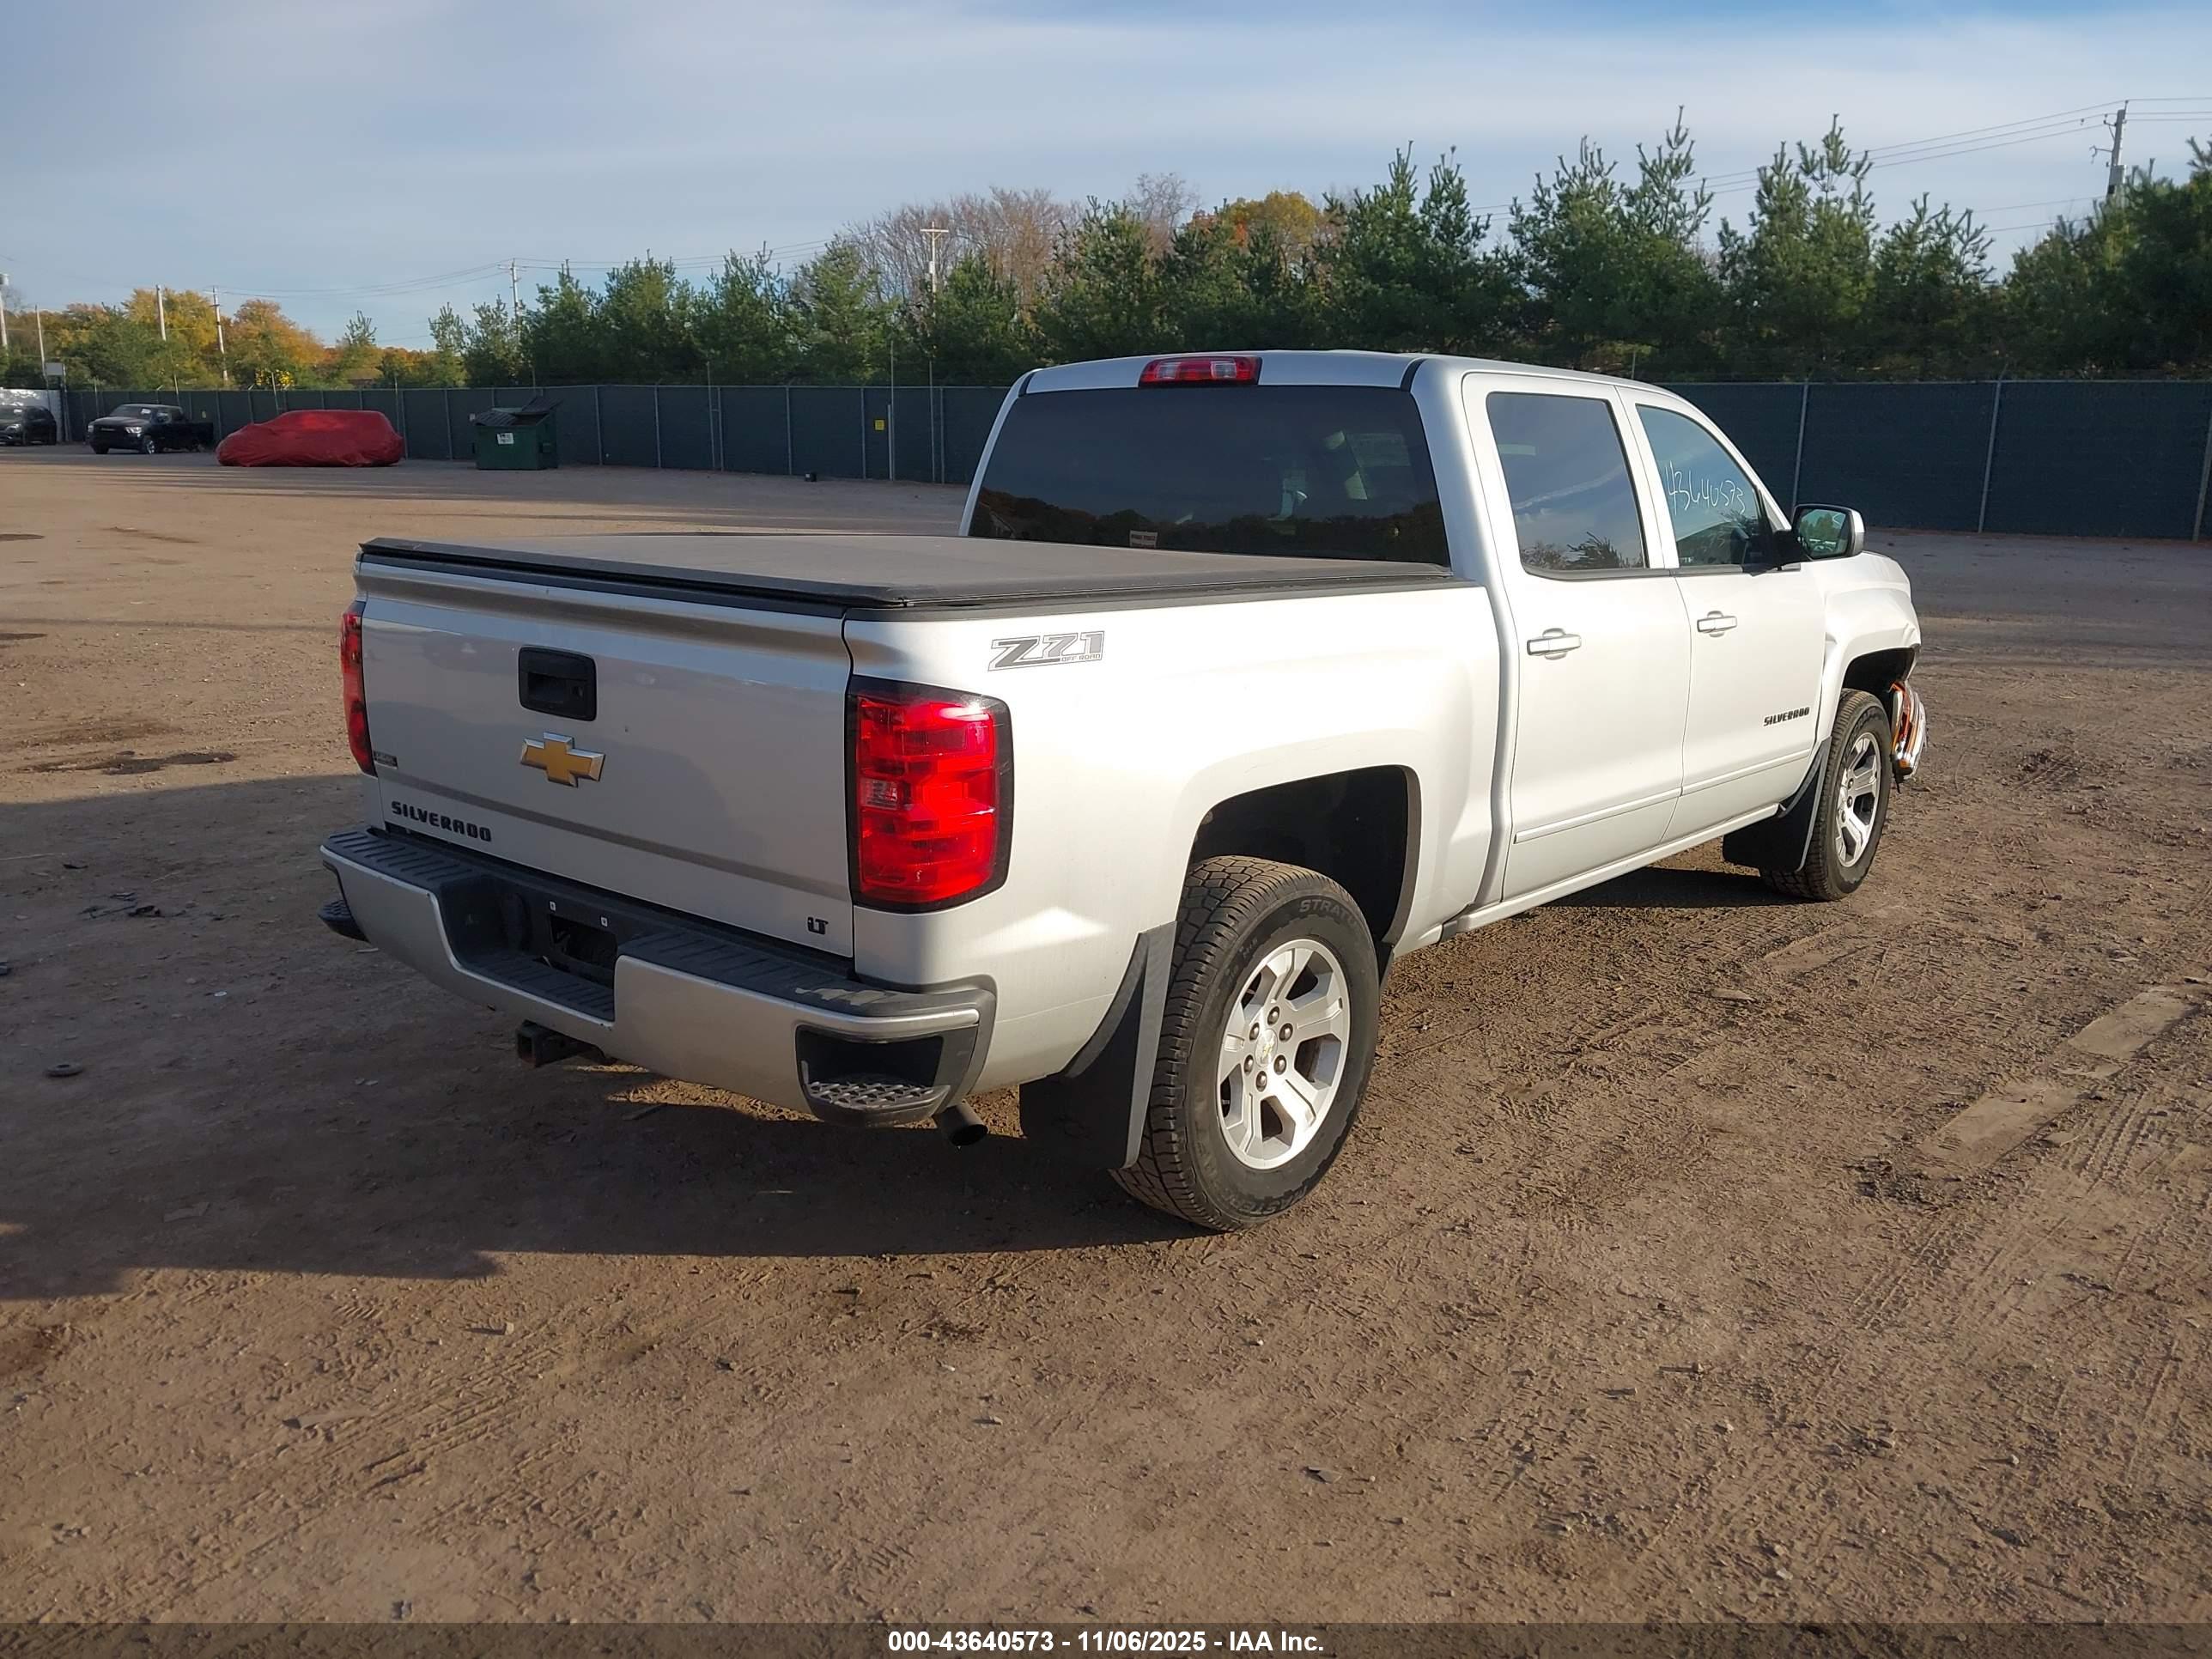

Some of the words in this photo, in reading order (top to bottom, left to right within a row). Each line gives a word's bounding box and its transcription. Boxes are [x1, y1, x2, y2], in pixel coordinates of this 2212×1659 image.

[1665, 459, 1746, 516] 43640573
[988, 630, 1105, 672] Z71
[1763, 706, 1810, 726] SILVERADO
[391, 800, 492, 842] SILVERADO
[807, 916, 829, 935] LT
